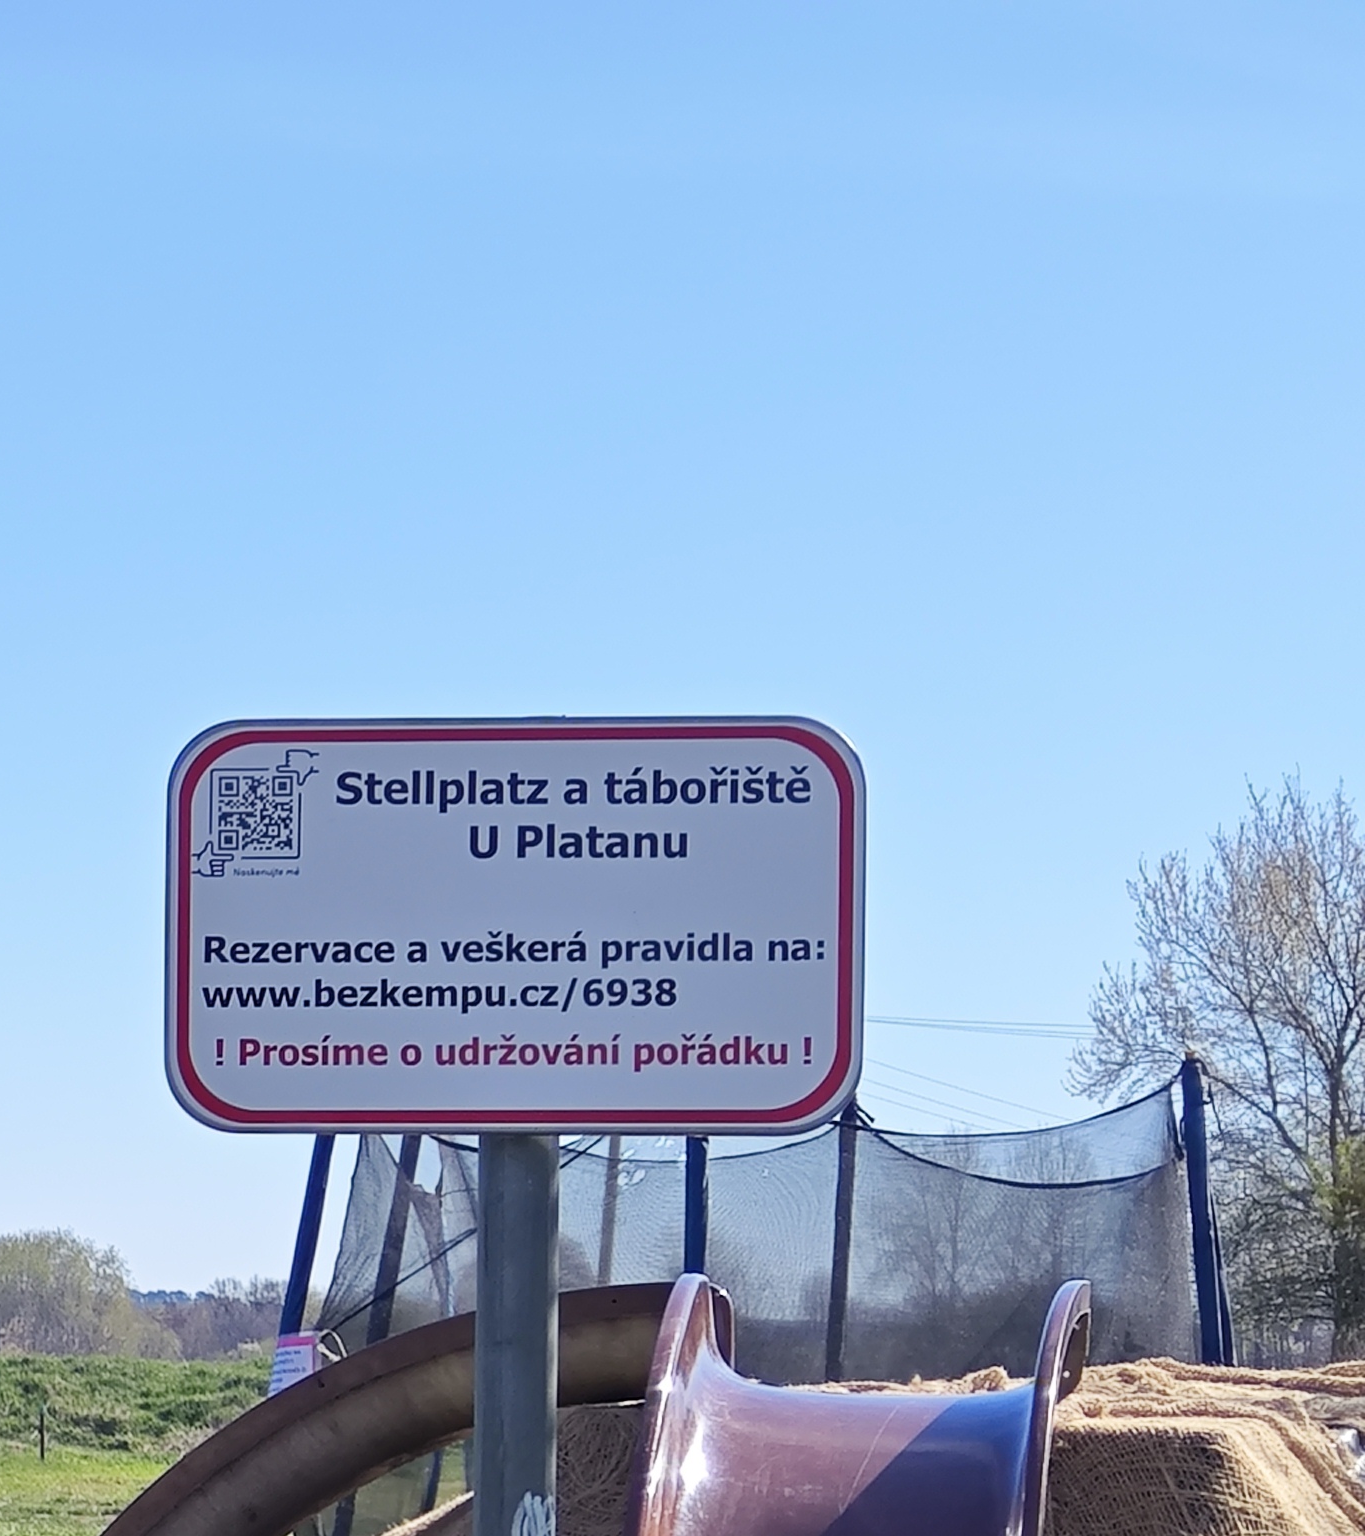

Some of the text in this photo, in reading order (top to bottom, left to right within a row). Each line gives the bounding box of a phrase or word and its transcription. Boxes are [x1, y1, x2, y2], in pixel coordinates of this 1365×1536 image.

[335, 765, 812, 814] Stellplatz a tábořiště
[469, 823, 689, 860] U Platanu
[233, 867, 284, 879] Naskenujte
[203, 930, 826, 970] Rezervace a veškerá pravidla na:
[202, 977, 678, 1015] www.bezkempu.cz/6938
[238, 1034, 389, 1067] Prosíme
[400, 1044, 422, 1066] o
[435, 1033, 621, 1067] udržování
[633, 1033, 789, 1074] pořádku
